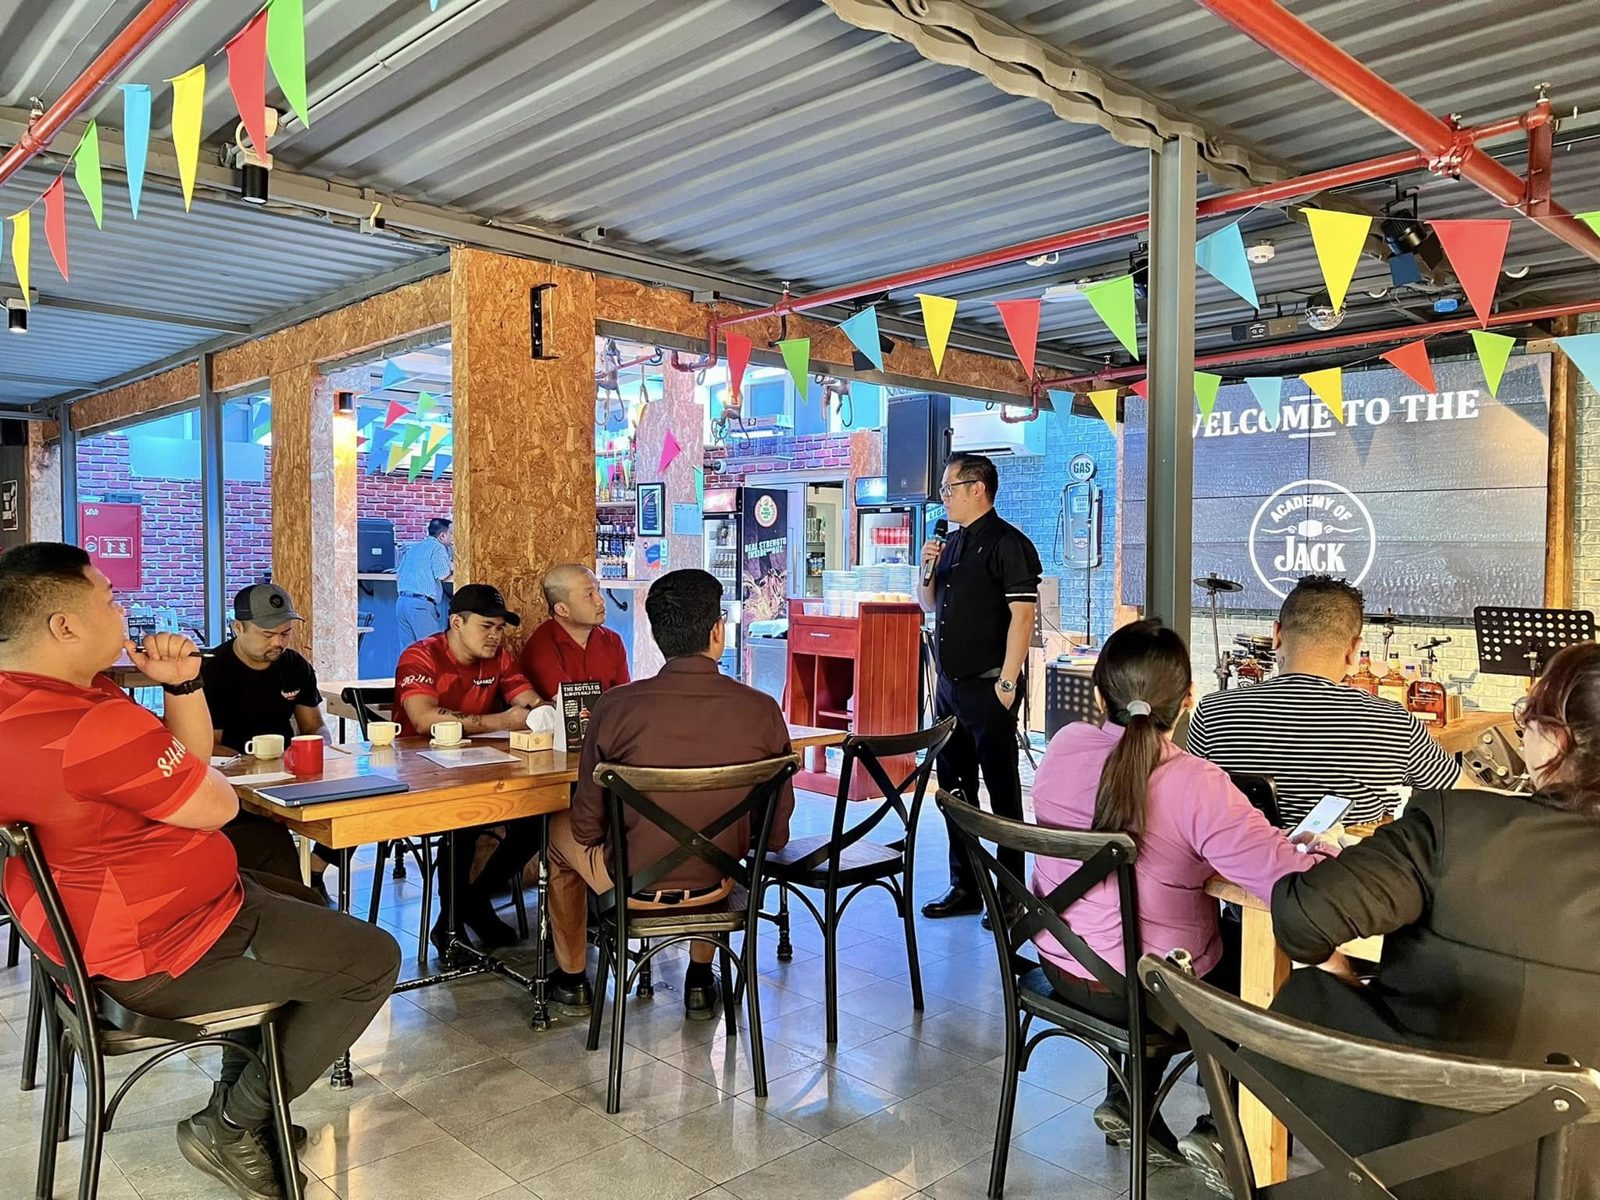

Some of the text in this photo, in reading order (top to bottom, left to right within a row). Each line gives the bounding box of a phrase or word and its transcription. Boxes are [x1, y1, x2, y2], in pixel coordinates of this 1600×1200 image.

[1342, 398, 1390, 427] TO
[1399, 389, 1480, 423] THE
[1073, 462, 1091, 474] GAS
[1270, 494, 1353, 523] ACADEMY OF
[1274, 535, 1347, 572] JACK
